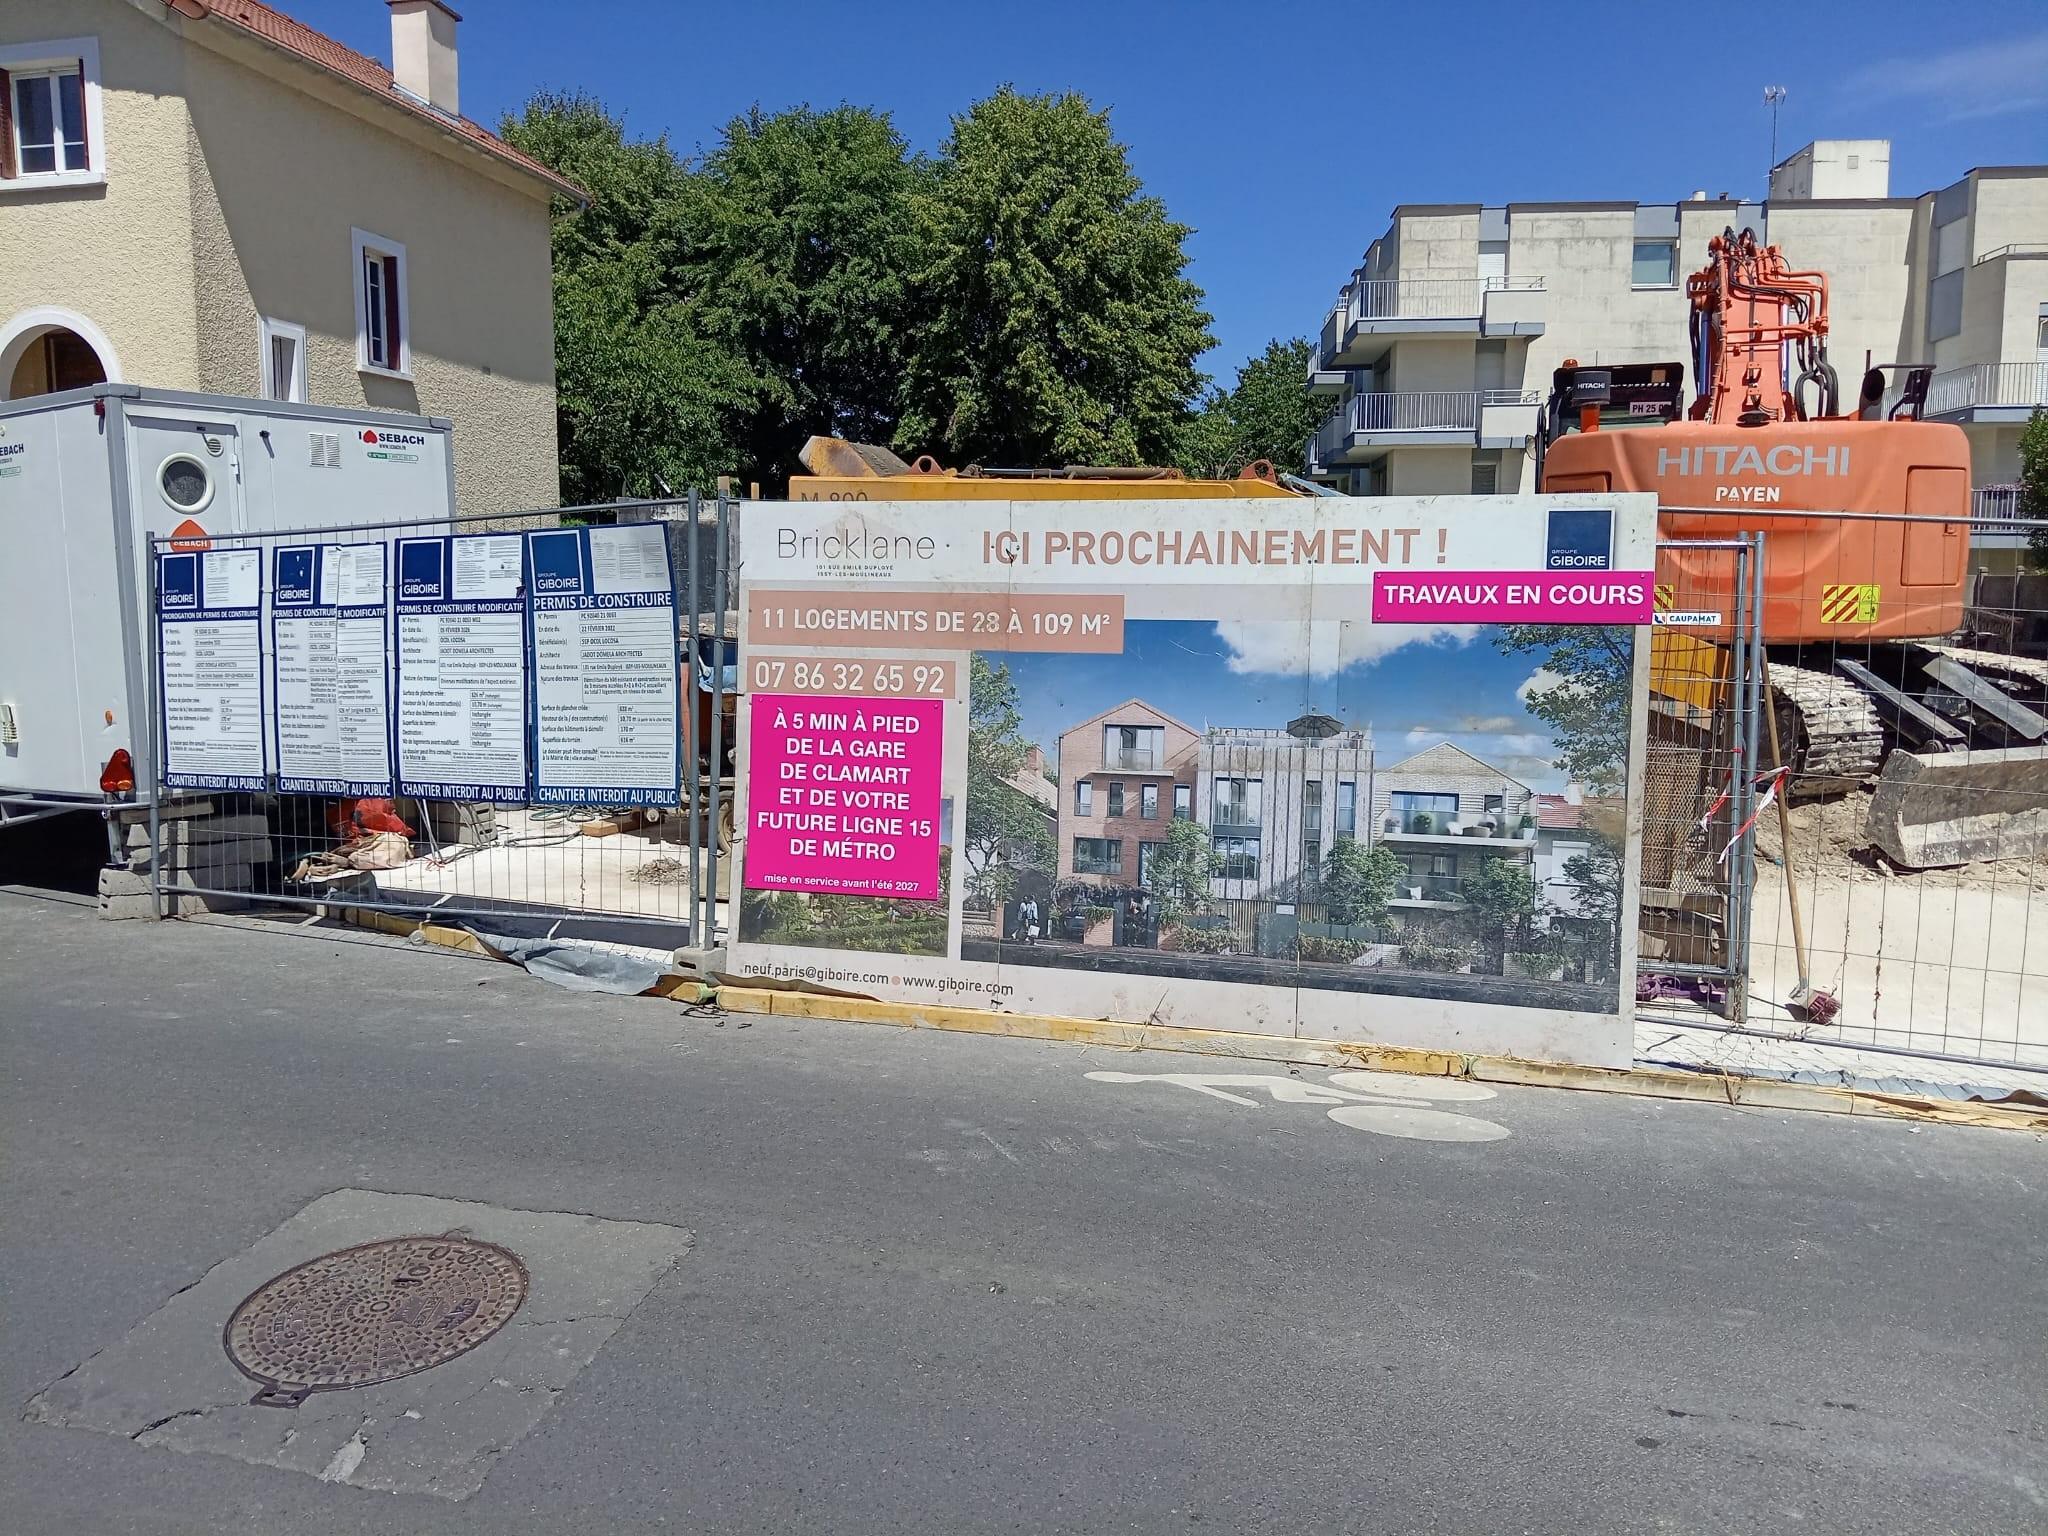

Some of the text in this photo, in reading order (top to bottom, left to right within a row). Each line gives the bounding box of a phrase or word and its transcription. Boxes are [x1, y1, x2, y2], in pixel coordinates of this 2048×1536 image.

[1632, 404, 1644, 413] PH
[1646, 404, 1656, 413] 25
[358, 431, 425, 445] I SEBACH
[0, 443, 24, 456] EBACH
[1656, 445, 1850, 477] HITACHI
[1715, 486, 1780, 502] PAYEN
[778, 528, 936, 560] Bricklane
[983, 528, 1448, 566] ICI PROCHAINEMENT !
[1550, 556, 1606, 567] GIBOIRE
[403, 583, 440, 594] GIBOIRE
[538, 577, 579, 589] GIBOIRE
[165, 594, 194, 604] GIBOIRE
[280, 589, 310, 600] GIBOIRE
[534, 592, 672, 610] PERMIS DE CONSTRUIRE
[1383, 584, 1644, 605] TRAVAUX EN COURS
[195, 611, 203, 619] DE
[203, 611, 220, 619] PERMIS
[221, 610, 228, 618] DE
[228, 610, 259, 618] CONSTRUIRE
[272, 608, 294, 618] PERMIS
[294, 608, 303, 617] DE
[343, 607, 387, 618] MODIFICATIF
[396, 602, 524, 614] PERMIS DE CONSTRUIRE MODIFICATIF
[763, 608, 1111, 635] 11 LOGEMENTS DE 28 À 109 M²
[754, 661, 944, 693] 07 86 32 65 92
[773, 706, 920, 734] À 5 MIN À PIED
[786, 737, 906, 759] DE LA GARE
[168, 774, 265, 790] CHANTIER INTERDIT AU PUBLIC
[780, 762, 911, 785] DE CLAMART
[281, 779, 315, 791] CHANTIER
[350, 783, 363, 795] AU
[364, 784, 391, 796] PUBLIC
[401, 783, 526, 800] CHANTIER INTERDIT AU PUBLIC
[538, 787, 676, 804] CHANTIER INTERDIT AU PUBLIC
[779, 787, 910, 810] ET DE VOTRE
[757, 811, 931, 837] FUTURE LIGNE 15
[790, 836, 896, 861] DE MÉTRO
[764, 874, 919, 892] mise en service avant l'été 2027
[744, 962, 1014, 996] neuf.paris@giboire.com www.giboire.com
